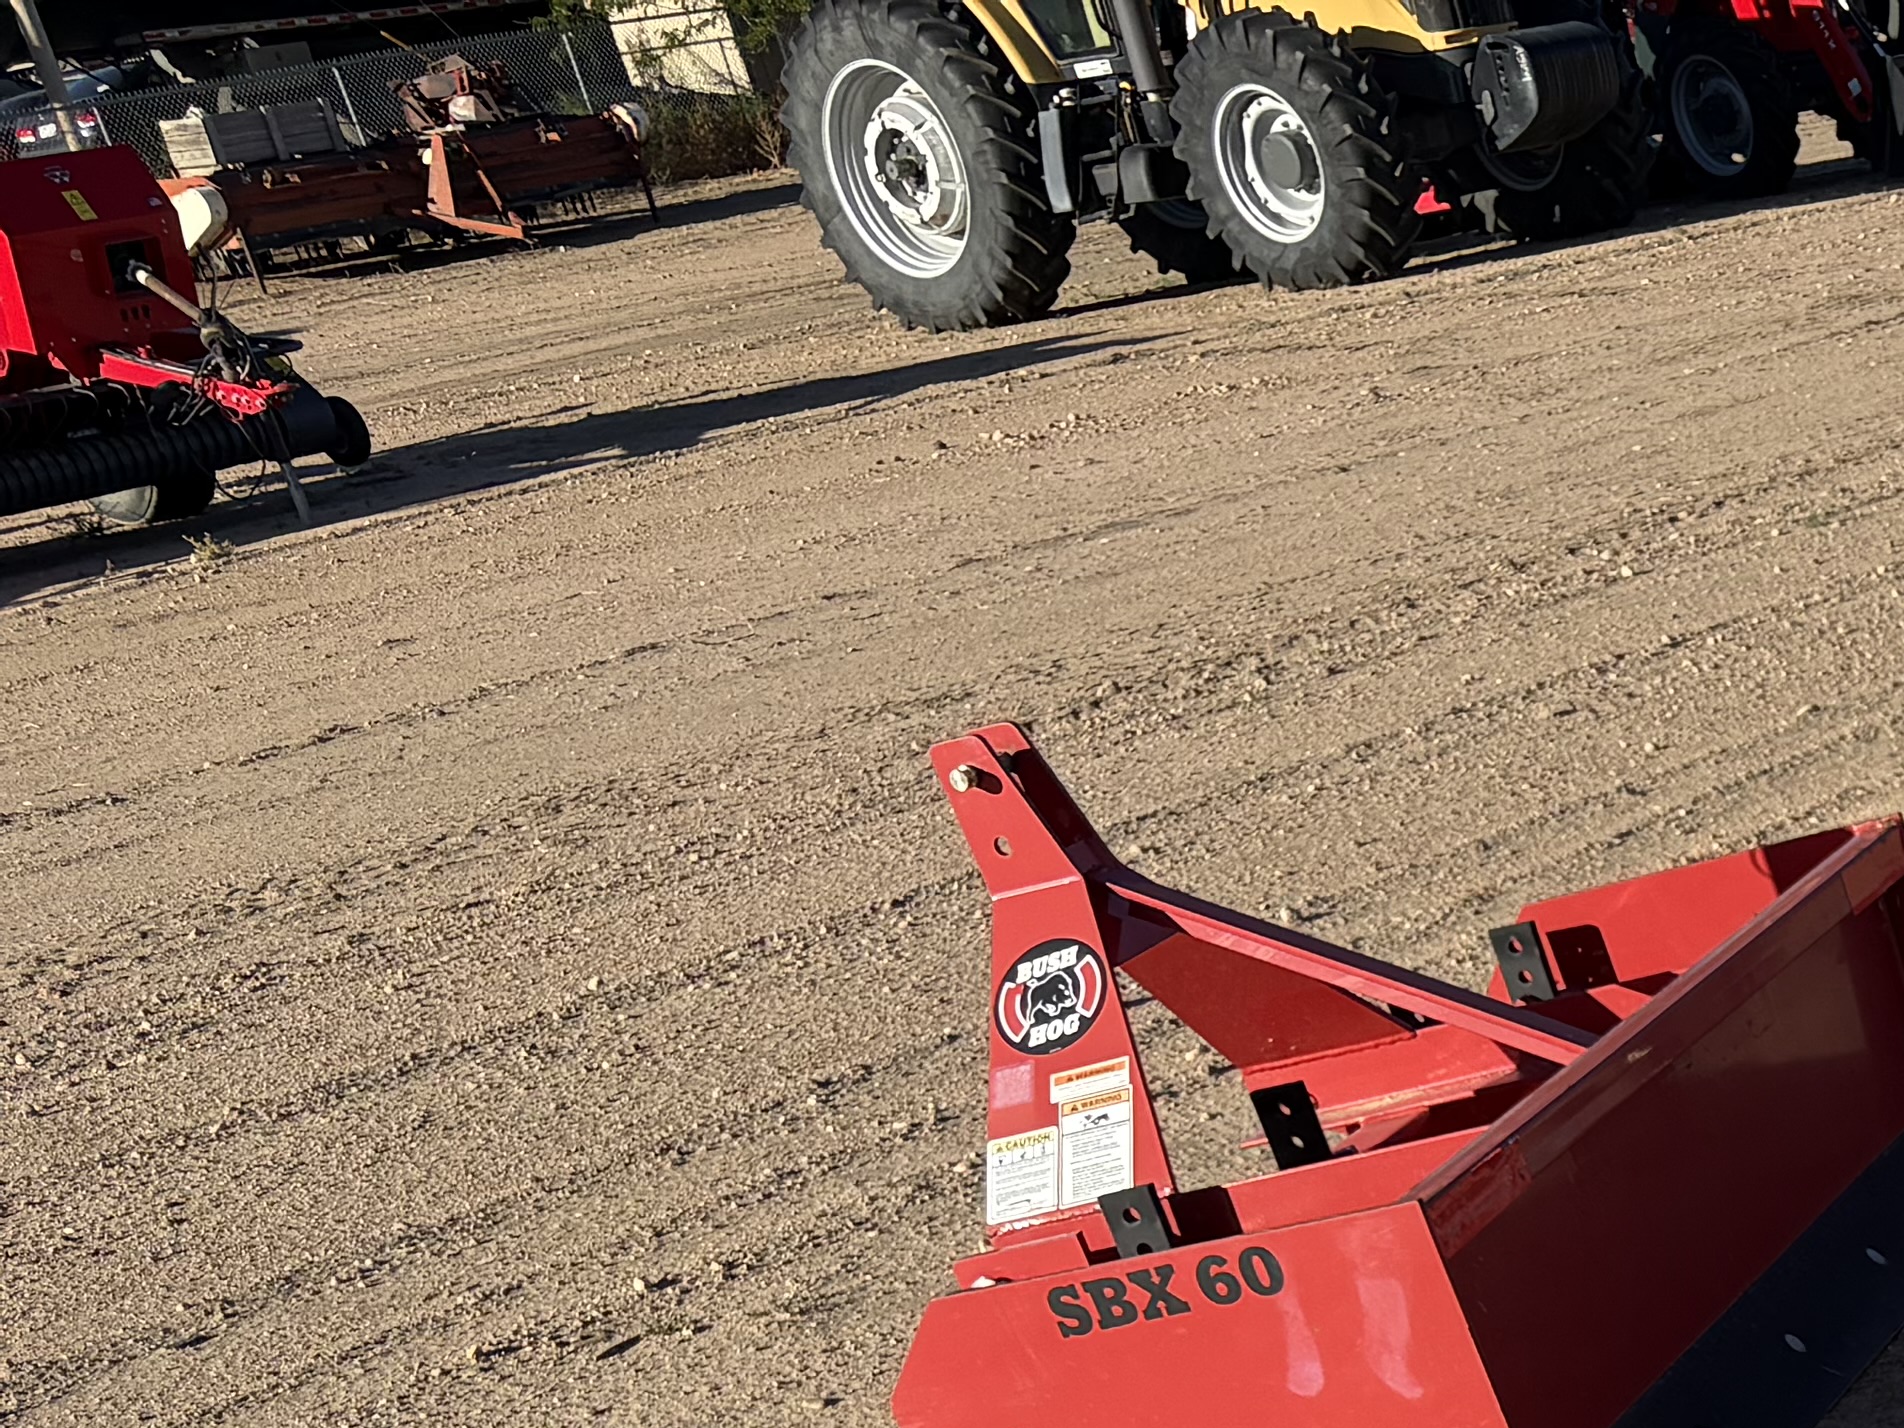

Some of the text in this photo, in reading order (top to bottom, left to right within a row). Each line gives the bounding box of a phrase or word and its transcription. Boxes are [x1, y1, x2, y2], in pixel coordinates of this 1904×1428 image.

[1016, 944, 1079, 983] BUSH
[1028, 1014, 1081, 1048] HOG
[1047, 1246, 1286, 1339] SBX 60
